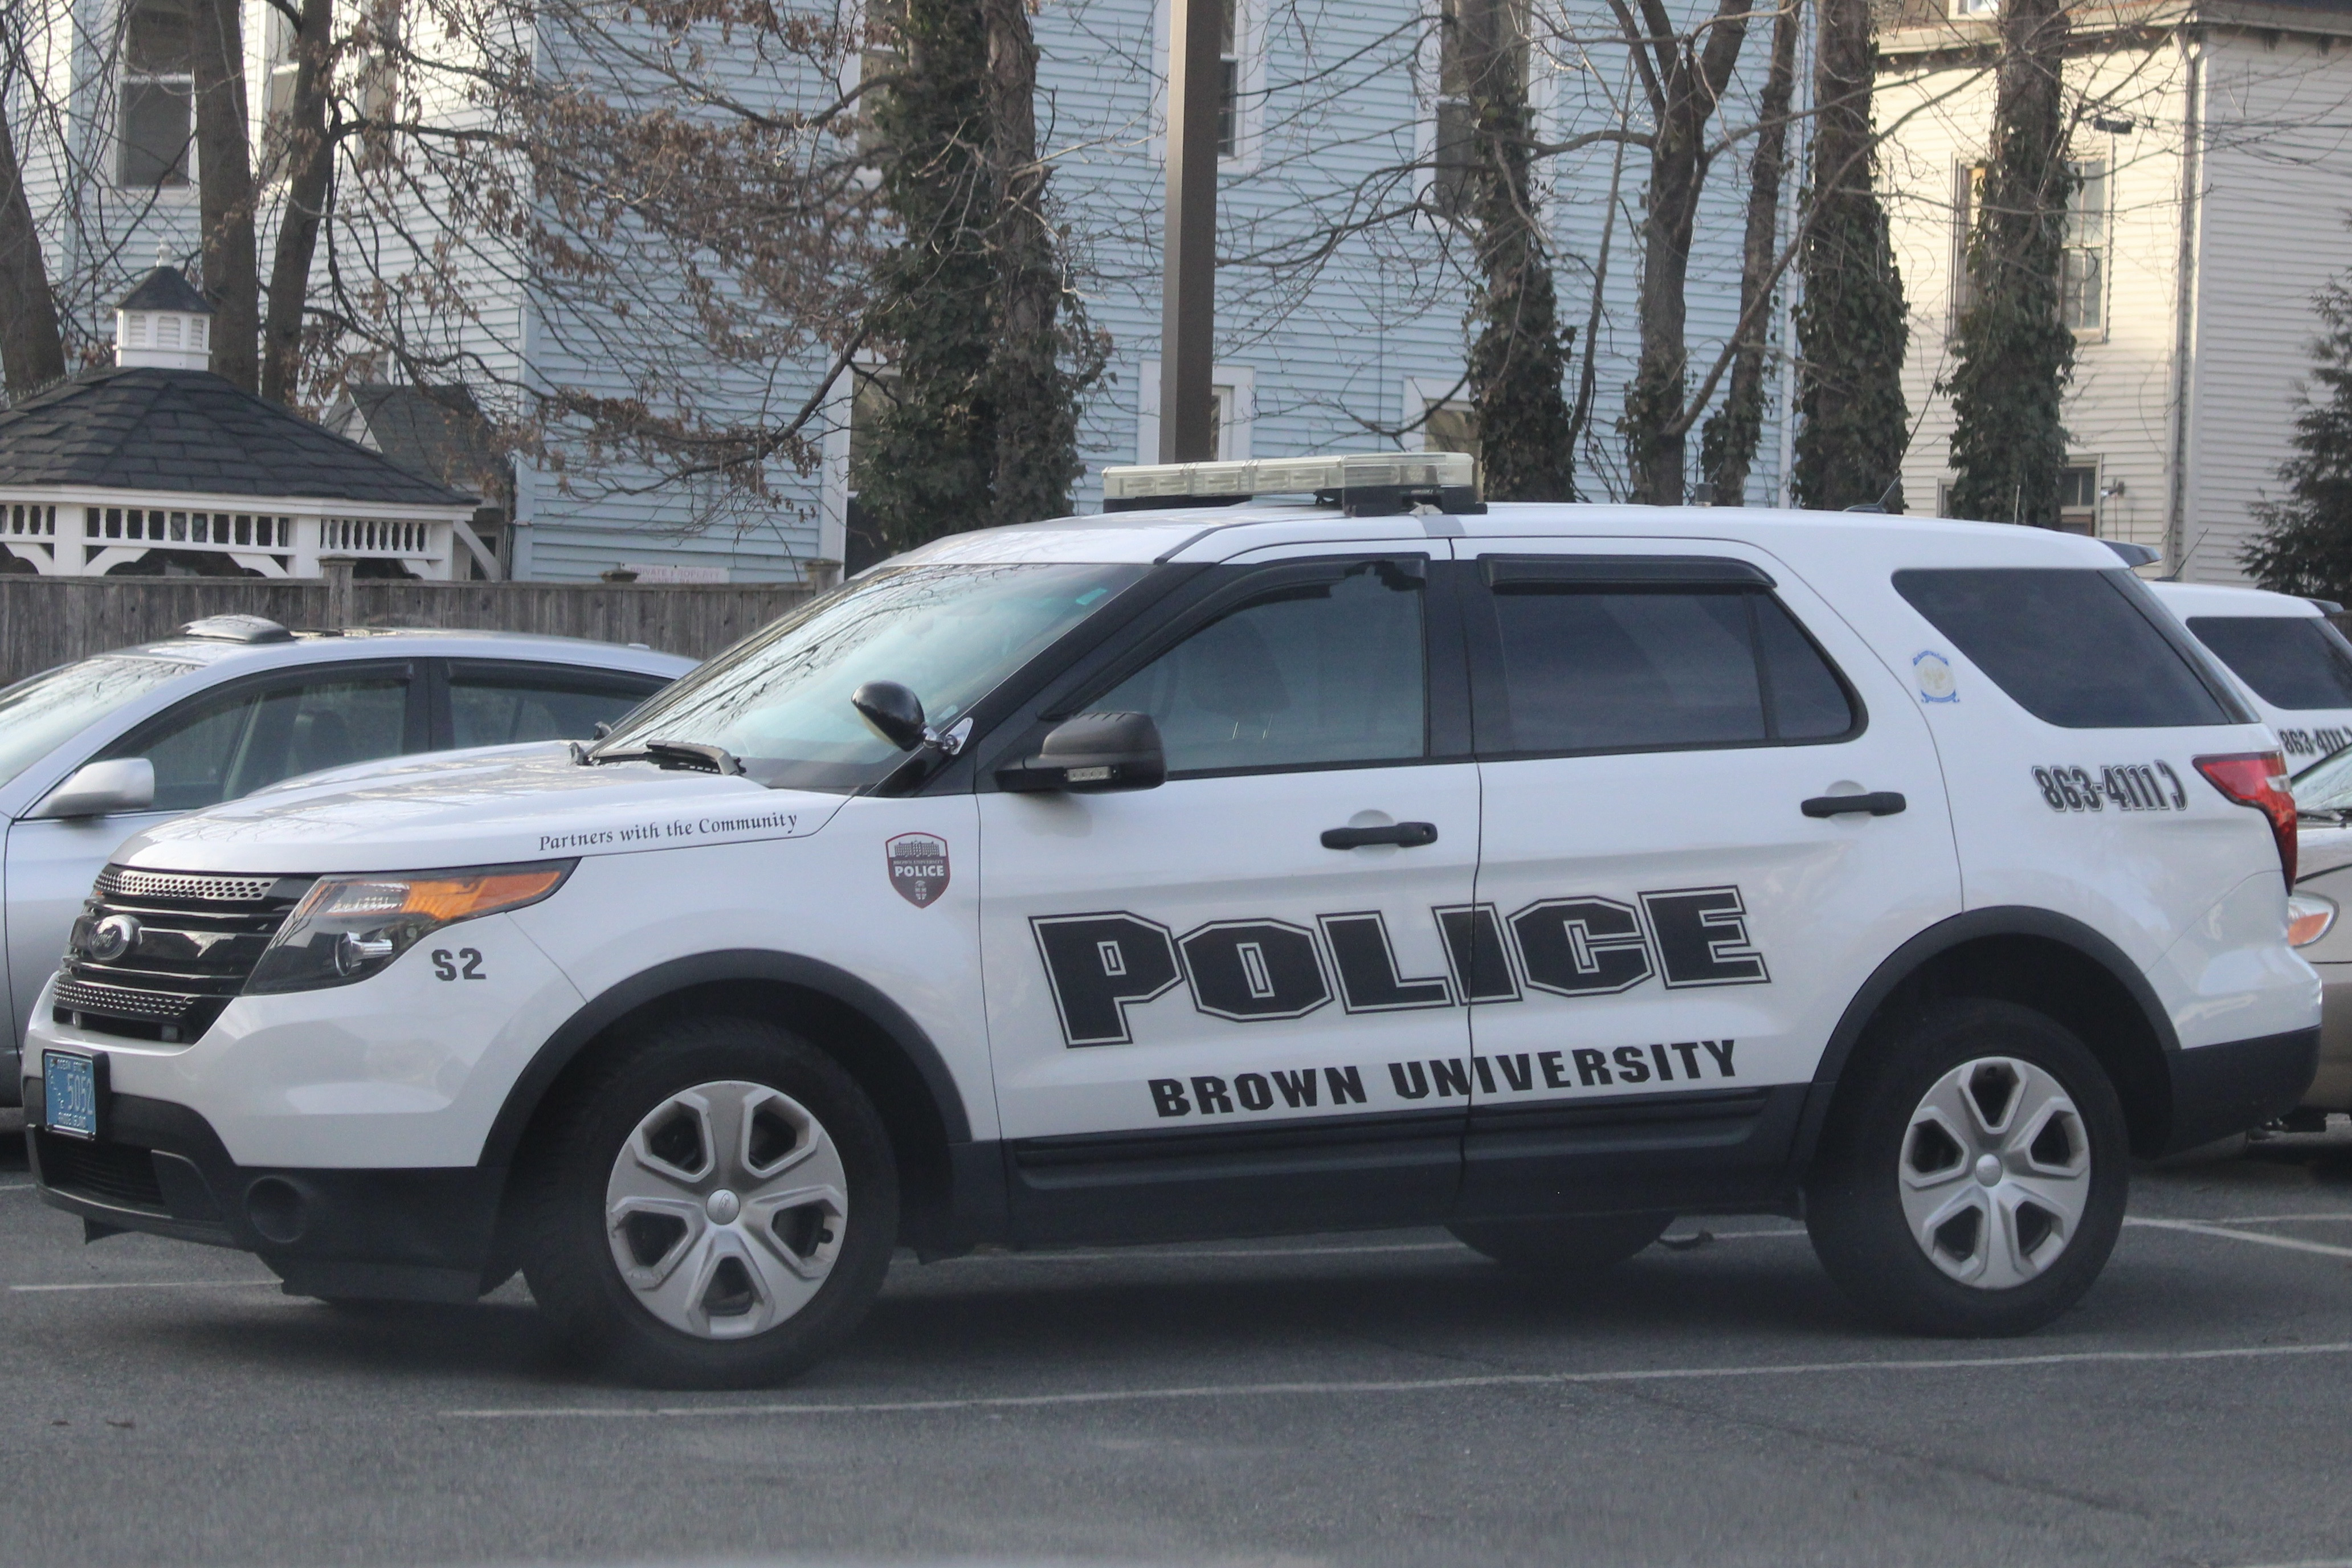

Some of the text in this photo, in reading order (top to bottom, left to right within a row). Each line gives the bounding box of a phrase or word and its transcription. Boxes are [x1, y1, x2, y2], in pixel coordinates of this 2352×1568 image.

[2278, 729, 2346, 755] 863-4111
[2032, 766, 2170, 811] 863-4111
[540, 811, 797, 851] Partners with the Community
[895, 865, 945, 877] POLICE
[431, 948, 487, 981] S2
[1028, 884, 1771, 1050] POLICE
[67, 1073, 93, 1116] 5052
[1149, 1040, 1736, 1117] BROWN UNIVERSITY
